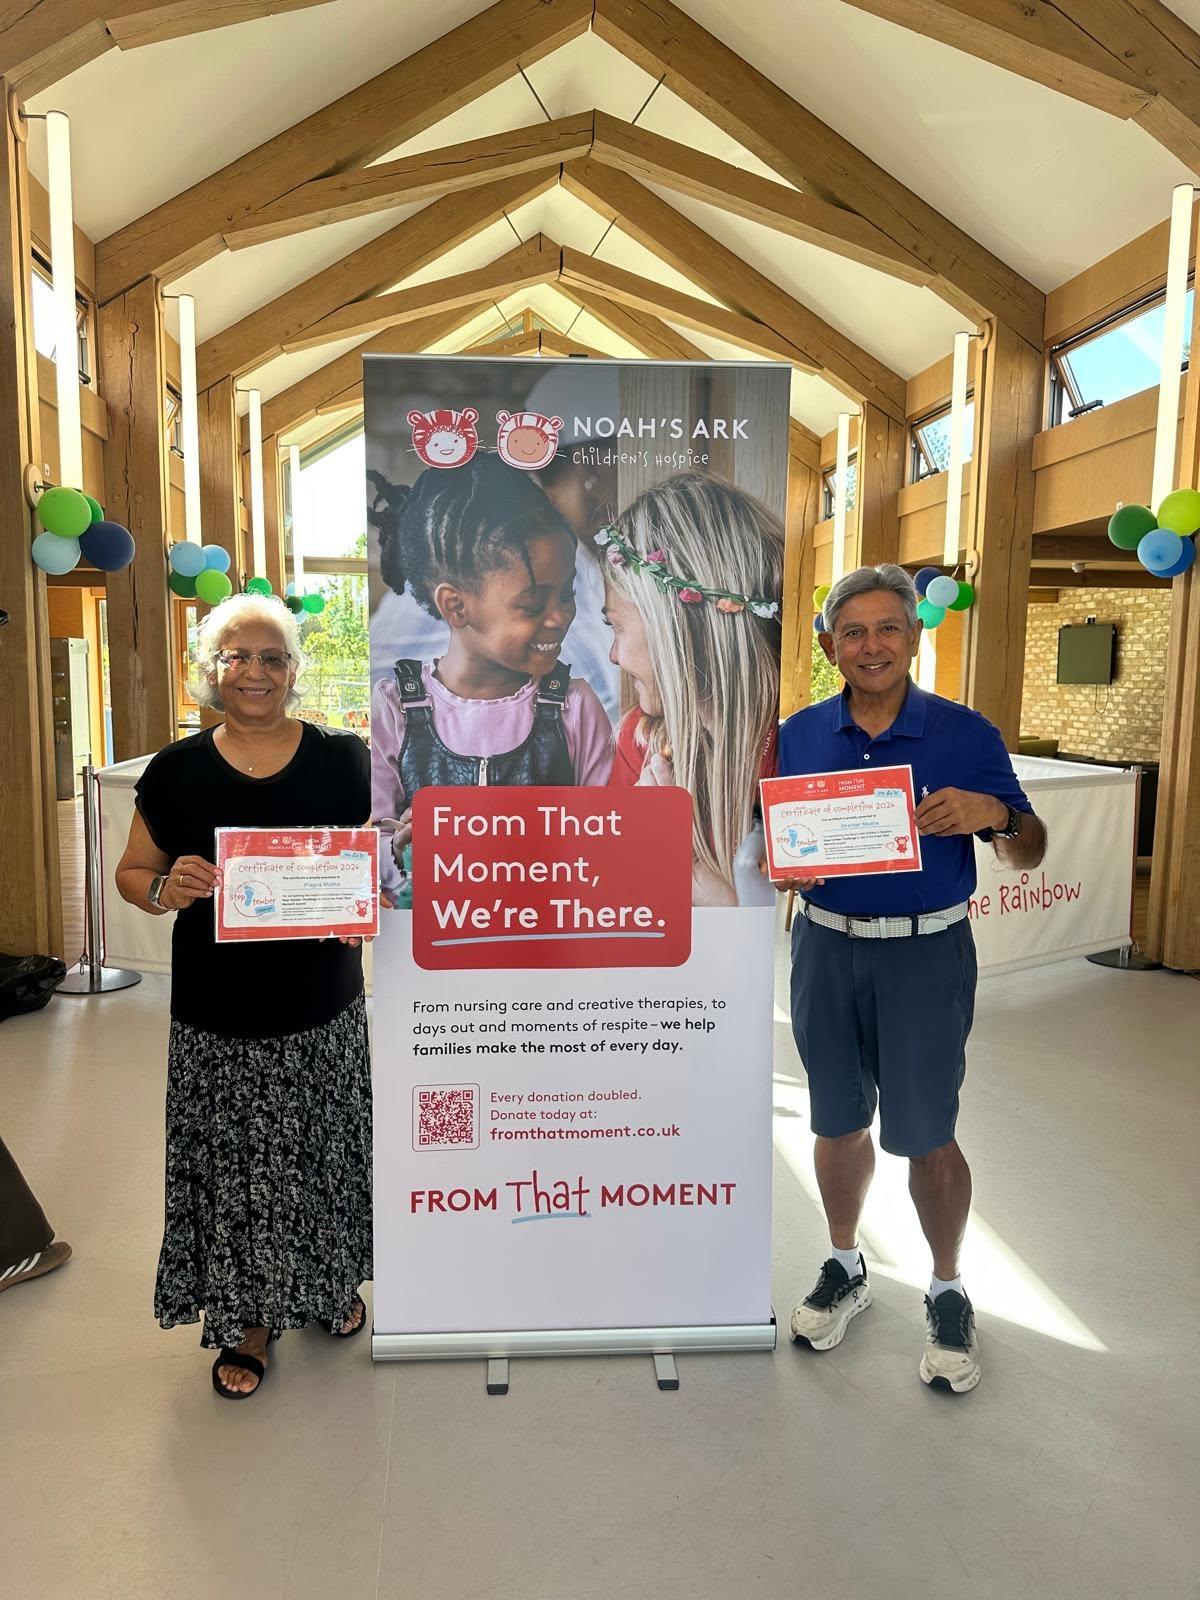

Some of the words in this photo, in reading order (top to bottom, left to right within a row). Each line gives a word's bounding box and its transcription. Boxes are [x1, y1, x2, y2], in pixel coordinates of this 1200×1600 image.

[573, 416, 684, 439] NOAH'S
[692, 418, 750, 440] ARK
[432, 806, 526, 836] From
[537, 806, 622, 836] That
[286, 862, 294, 872] of
[433, 853, 600, 888] Moment,
[431, 899, 539, 929] We're
[549, 898, 666, 928] There.
[413, 1001, 450, 1014] From
[454, 1000, 507, 1014] nursing
[511, 1001, 543, 1012] care
[546, 998, 574, 1012] and
[578, 998, 634, 1011] creative
[638, 997, 708, 1012] therapies,
[711, 998, 726, 1010] to
[413, 1023, 446, 1038] days
[450, 1022, 474, 1034] out
[479, 1021, 506, 1033] and
[510, 1021, 578, 1032] moments
[583, 1019, 598, 1032] of
[685, 1018, 716, 1033] help
[412, 1043, 472, 1056] families
[476, 1042, 517, 1054] make
[521, 1042, 546, 1053] the
[550, 1042, 586, 1053] most
[590, 1040, 606, 1052] of
[610, 1041, 648, 1054] every
[652, 1039, 683, 1054] day.
[490, 1092, 524, 1105] Every
[528, 1091, 584, 1102] donation
[588, 1090, 642, 1102] doubled.
[490, 1110, 536, 1121] Donate
[540, 1109, 576, 1122] today
[580, 1109, 598, 1120] at:
[490, 1124, 681, 1141] fromthatmoment.co.uk
[410, 1188, 497, 1214] FROM
[505, 1169, 591, 1216] That
[601, 1183, 737, 1208] MOMENT
